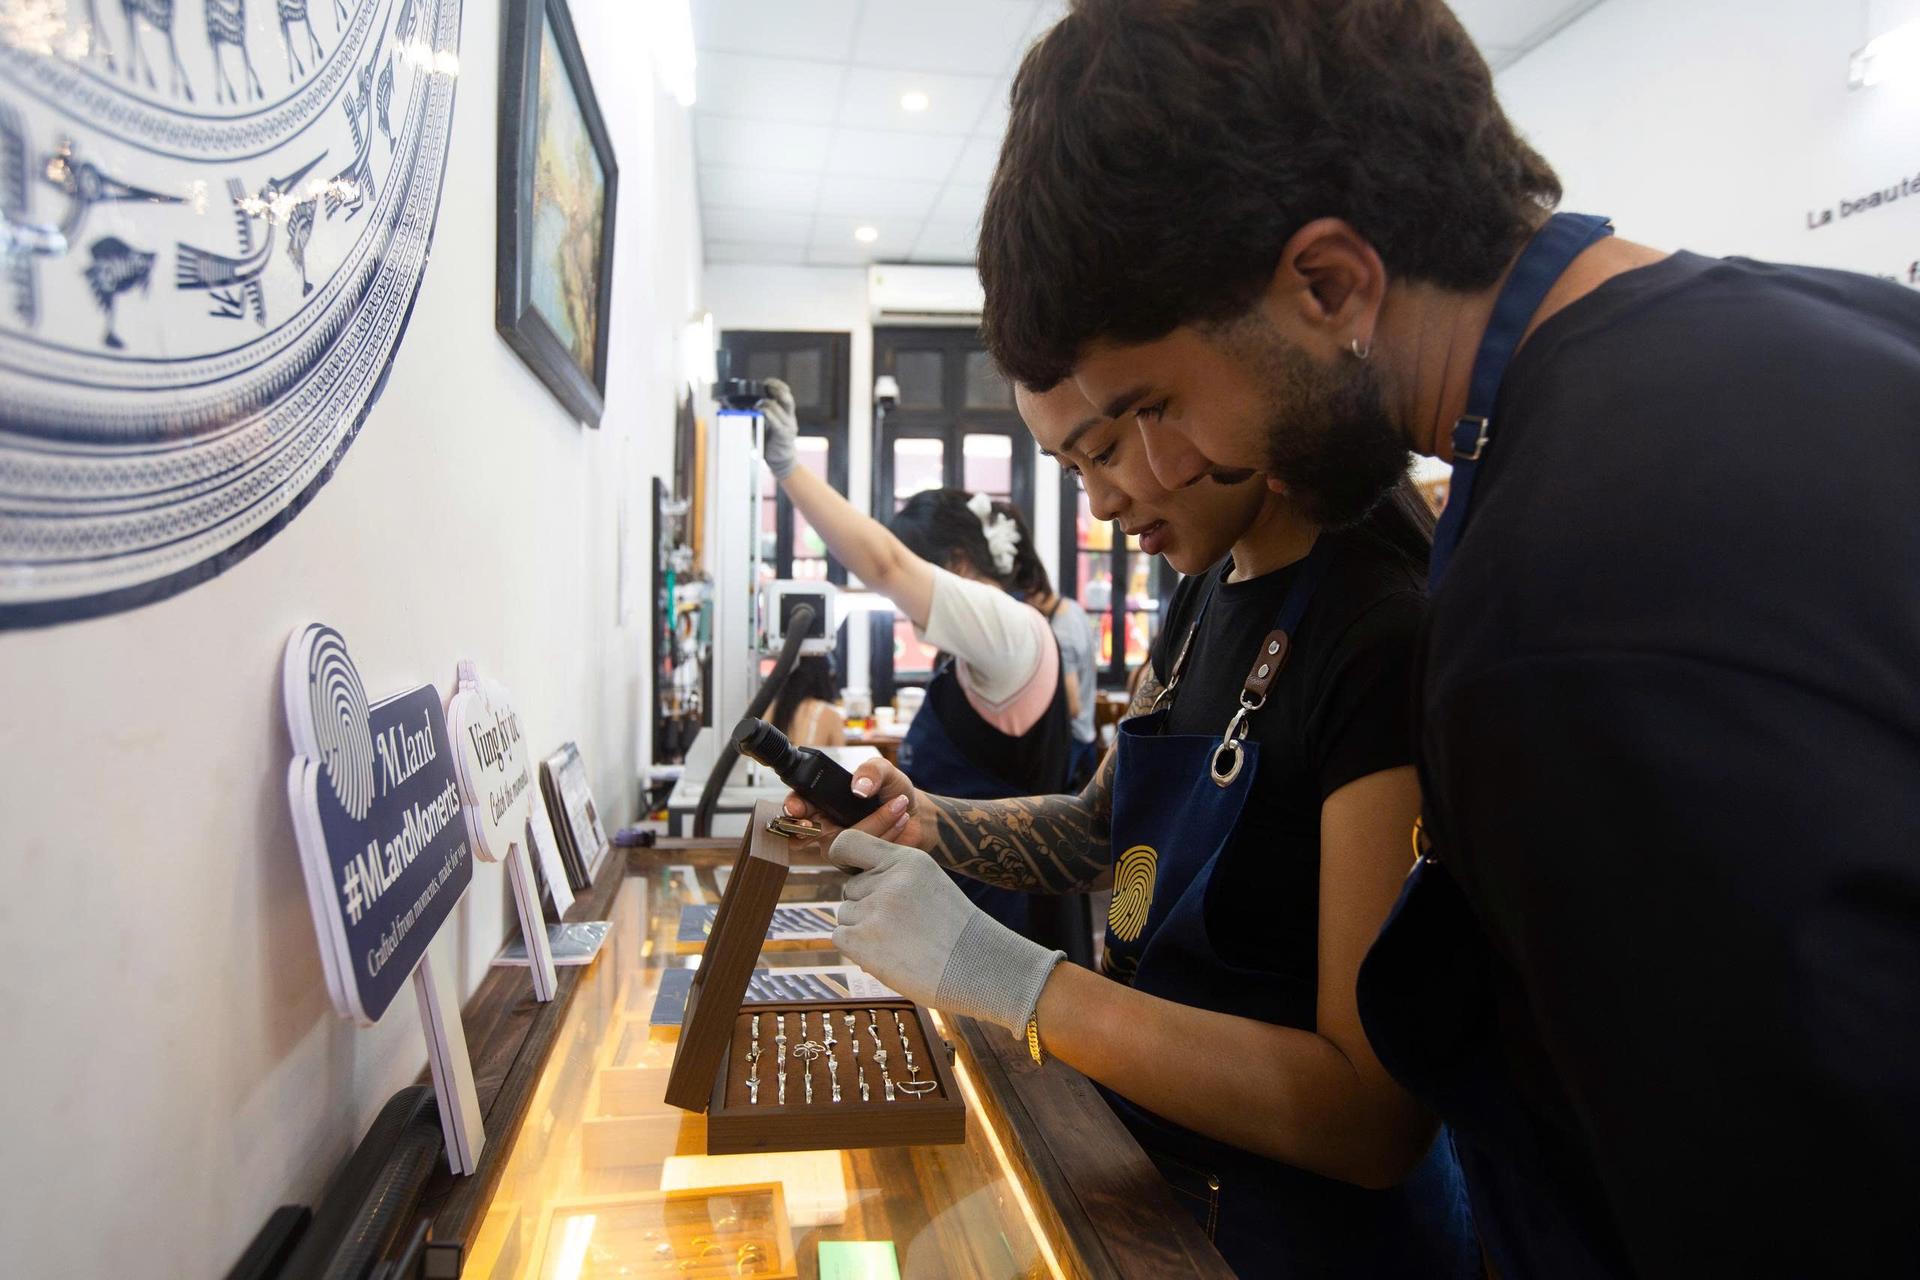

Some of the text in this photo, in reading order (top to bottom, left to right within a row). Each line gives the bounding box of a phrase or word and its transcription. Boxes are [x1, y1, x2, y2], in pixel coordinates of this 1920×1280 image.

[1807, 207, 1832, 230] La
[468, 721, 504, 772] Vùng
[343, 778, 460, 926] #MLandMoments
[368, 921, 400, 978] Crafted
[396, 914, 415, 941] from
[438, 854, 452, 886] made
[450, 848, 459, 870] for
[458, 841, 467, 866] you
